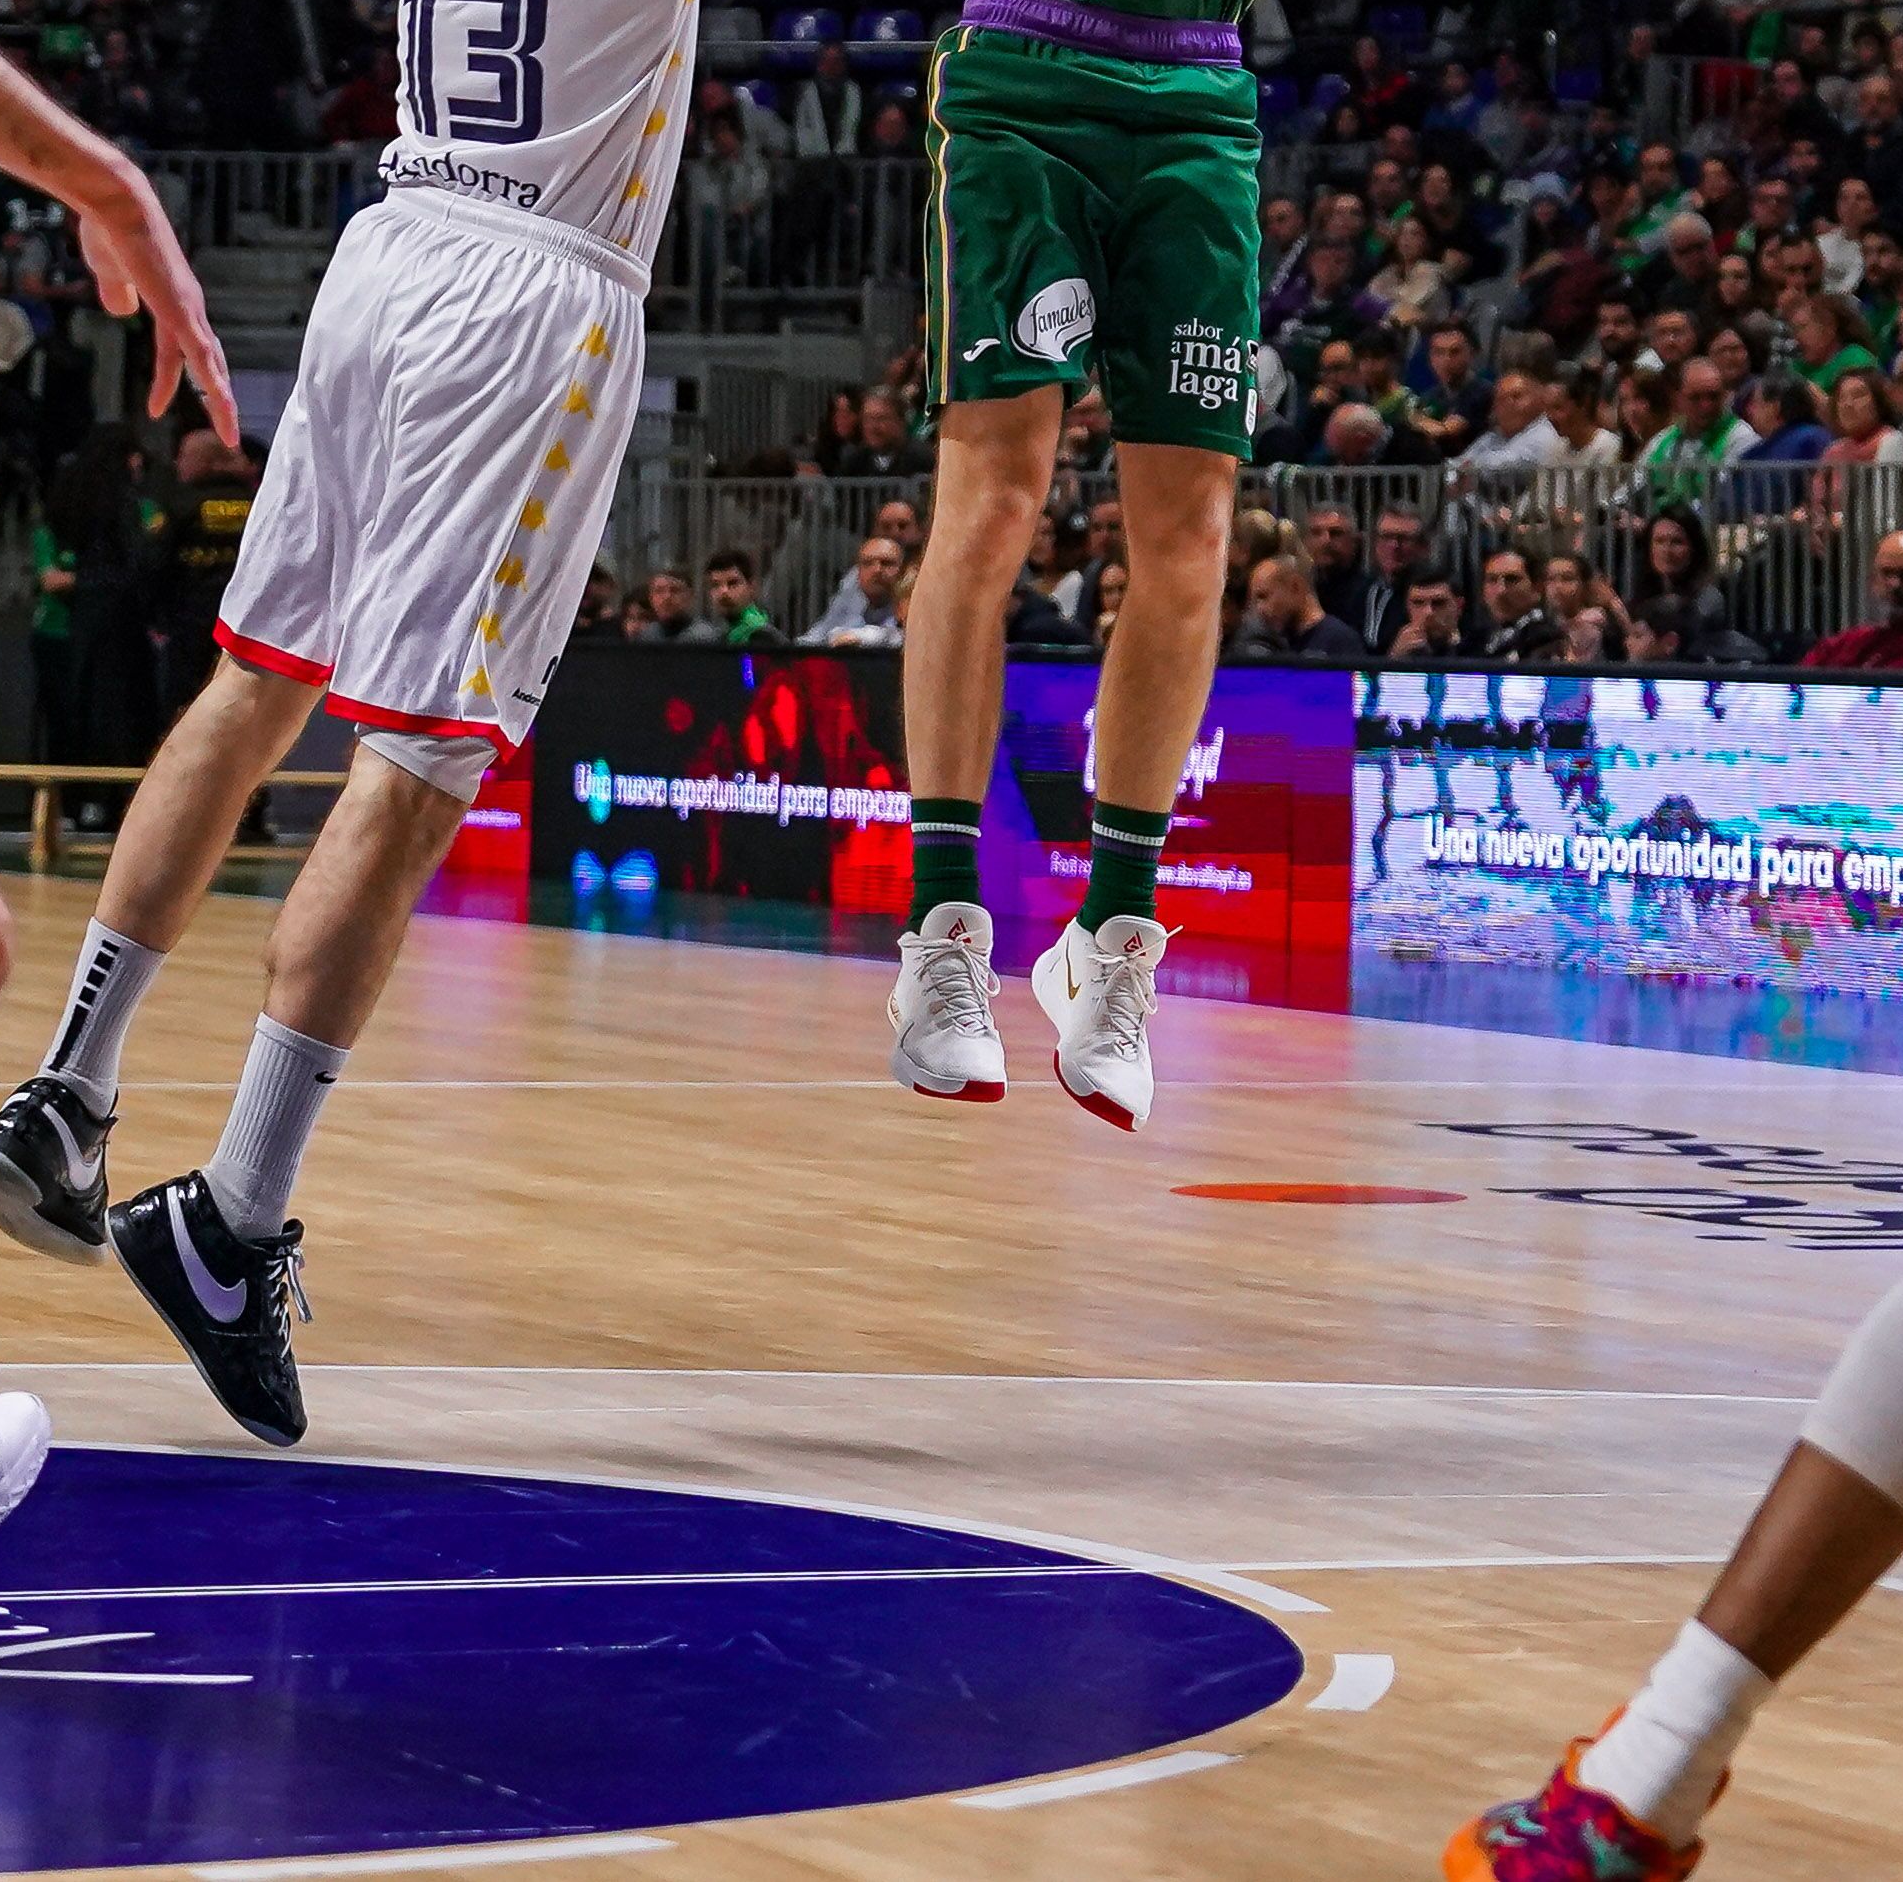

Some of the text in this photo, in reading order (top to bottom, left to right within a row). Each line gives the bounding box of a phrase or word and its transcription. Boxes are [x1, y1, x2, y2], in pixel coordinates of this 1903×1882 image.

[1174, 317, 1224, 341] sabor
[1170, 335, 1243, 374] a má
[1168, 359, 1239, 410] laga
[829, 787, 912, 831] empeza
[1424, 812, 1477, 863] Una
[1484, 828, 1565, 869] nueva
[1572, 827, 1753, 885] oportunidad
[1759, 847, 1835, 897] para
